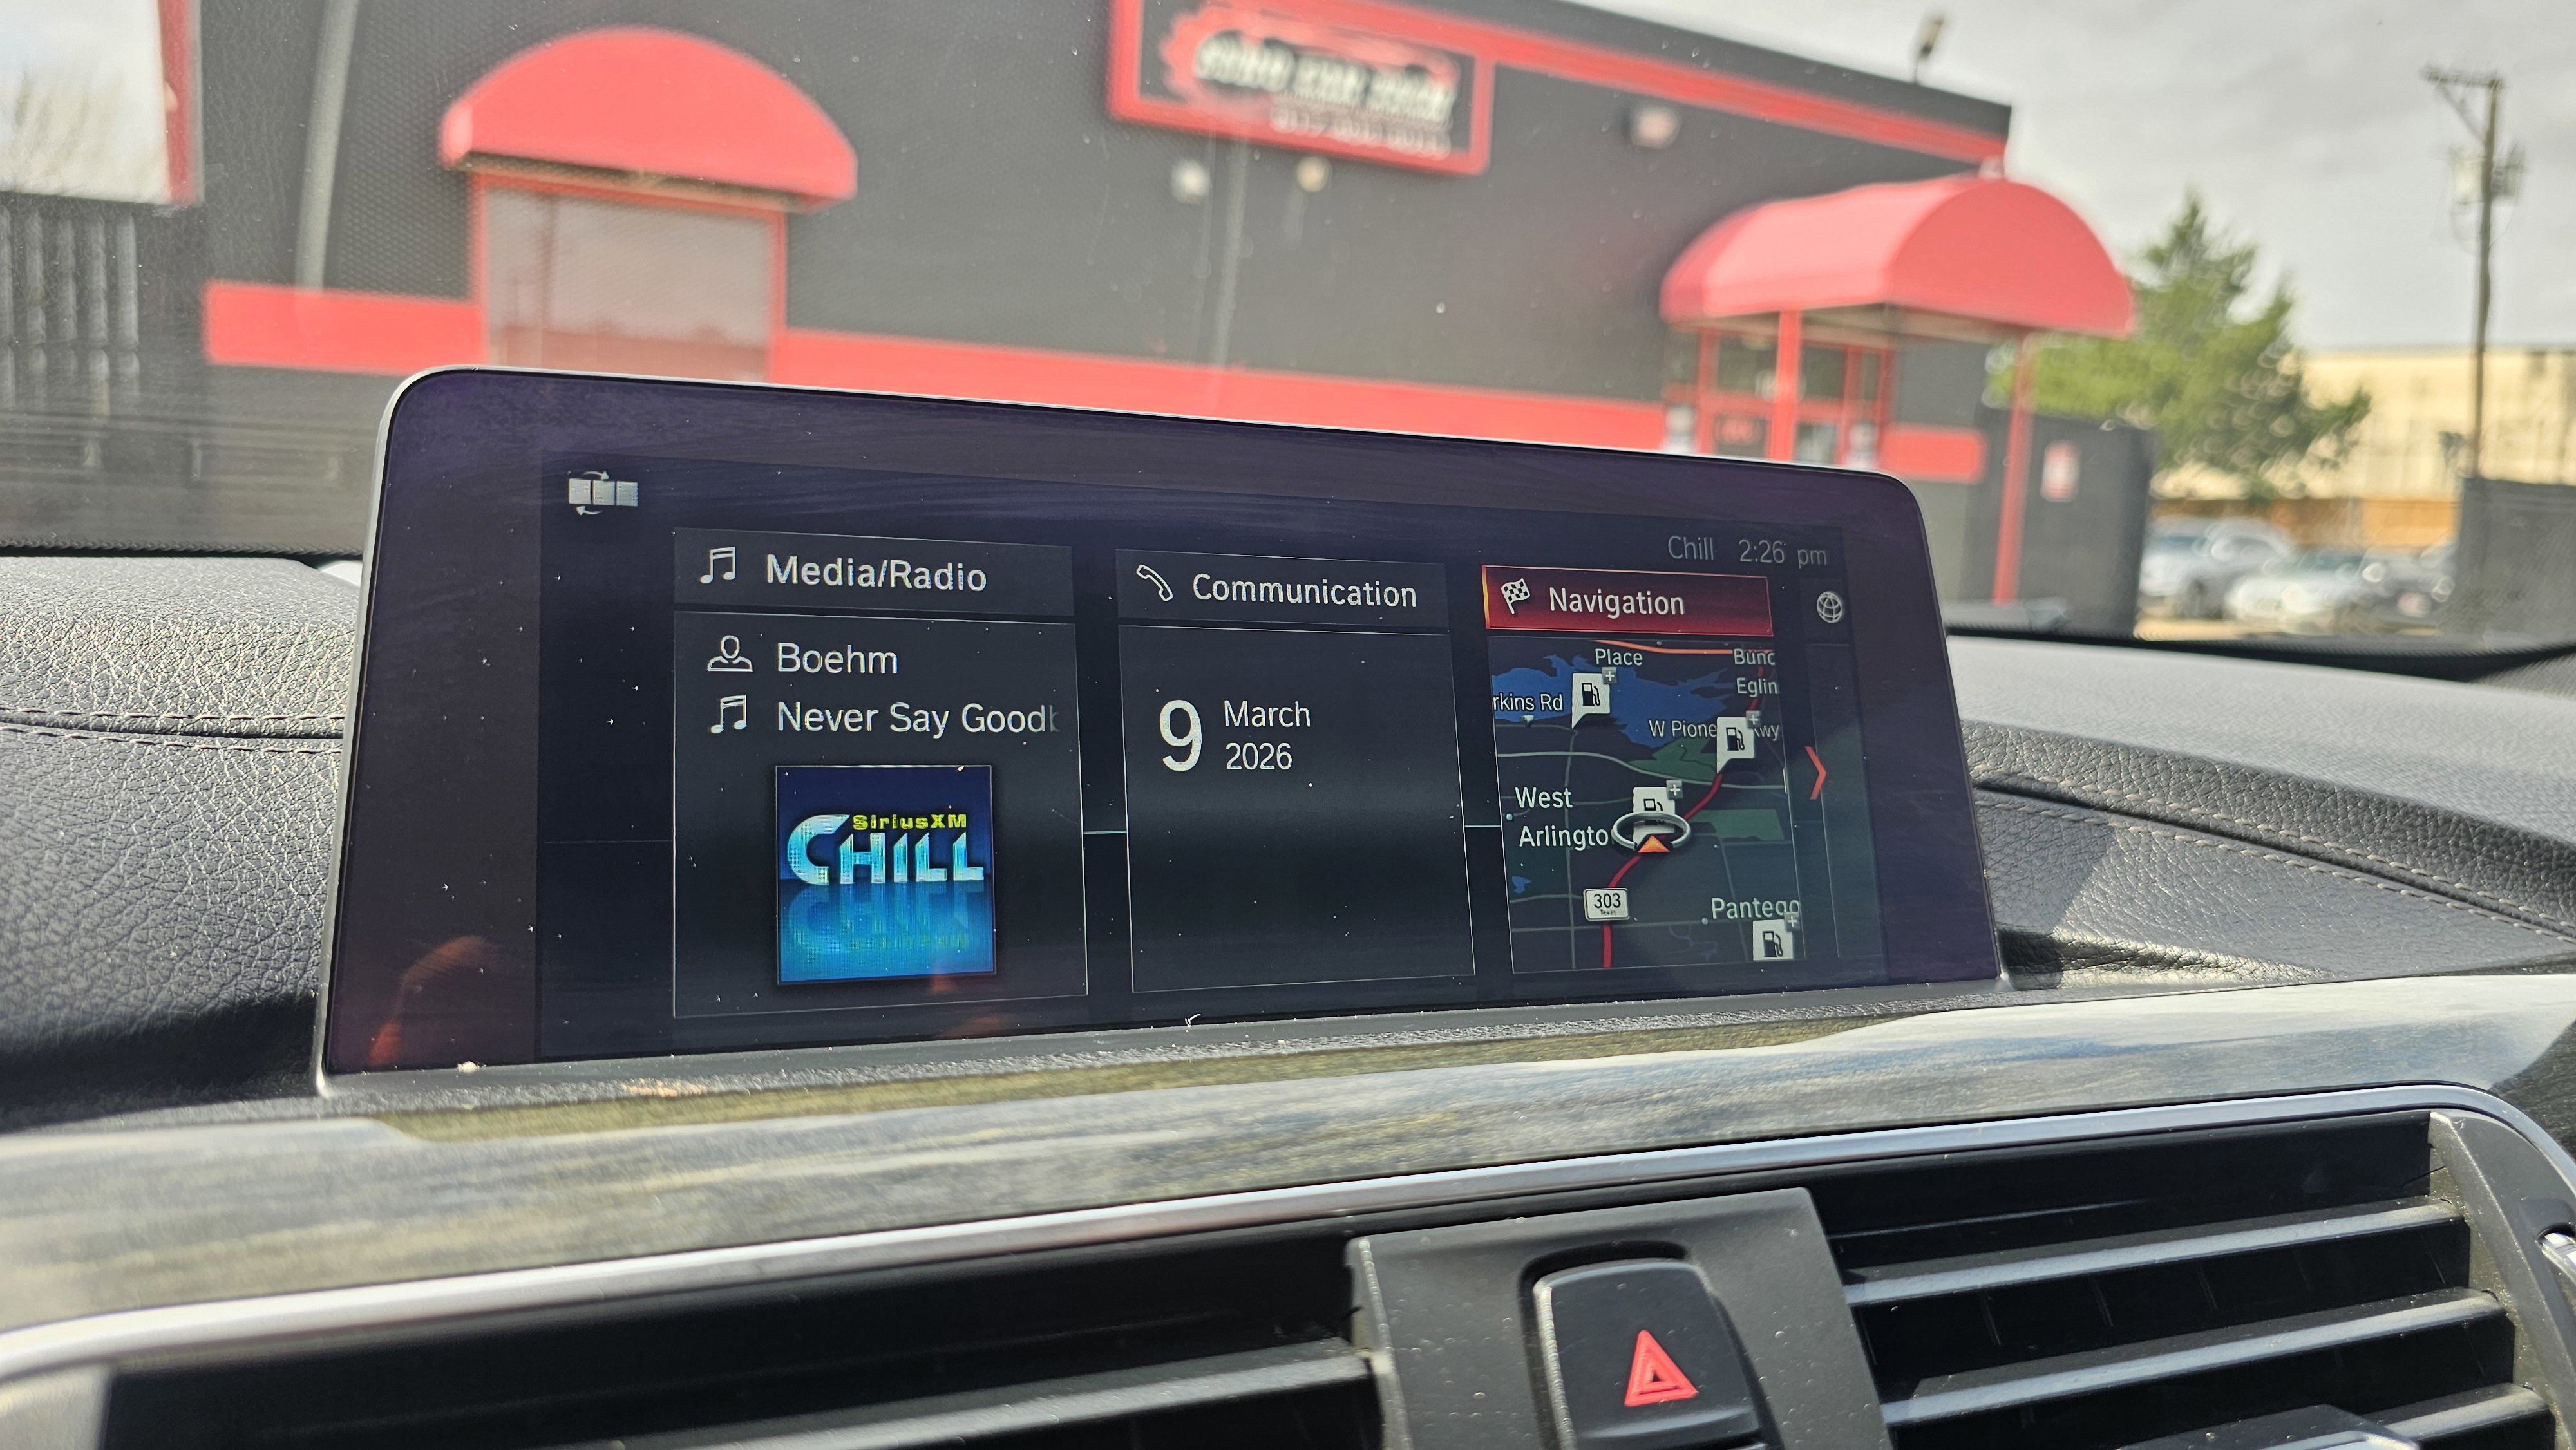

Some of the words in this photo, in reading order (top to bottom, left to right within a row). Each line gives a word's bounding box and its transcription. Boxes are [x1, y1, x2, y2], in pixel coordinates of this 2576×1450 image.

[1667, 535, 1716, 561] Chill
[1739, 538, 1786, 564] 2:26
[1797, 547, 1828, 569] pm
[766, 554, 987, 592] Media/Radio
[1193, 573, 1417, 608] Communication
[1549, 586, 1685, 619] Navigation
[777, 643, 898, 674] Boehm
[1595, 648, 1643, 666] Place
[1733, 648, 1776, 666] Bunc
[1736, 677, 1778, 698] Eglin
[1224, 699, 1311, 728] March
[1493, 693, 1535, 711] rkins
[1540, 693, 1563, 711] Rd
[777, 701, 879, 733] Never
[890, 702, 950, 739] Say
[1649, 720, 1665, 737] W
[1671, 720, 1718, 738] Pione
[1159, 699, 1202, 772] 9
[1226, 742, 1293, 770] 2026
[1515, 787, 1573, 808] West
[852, 813, 967, 831] SiriusXM
[787, 814, 984, 885] CHILL
[1519, 825, 1614, 851] Arlingto
[1594, 892, 1621, 909] 303
